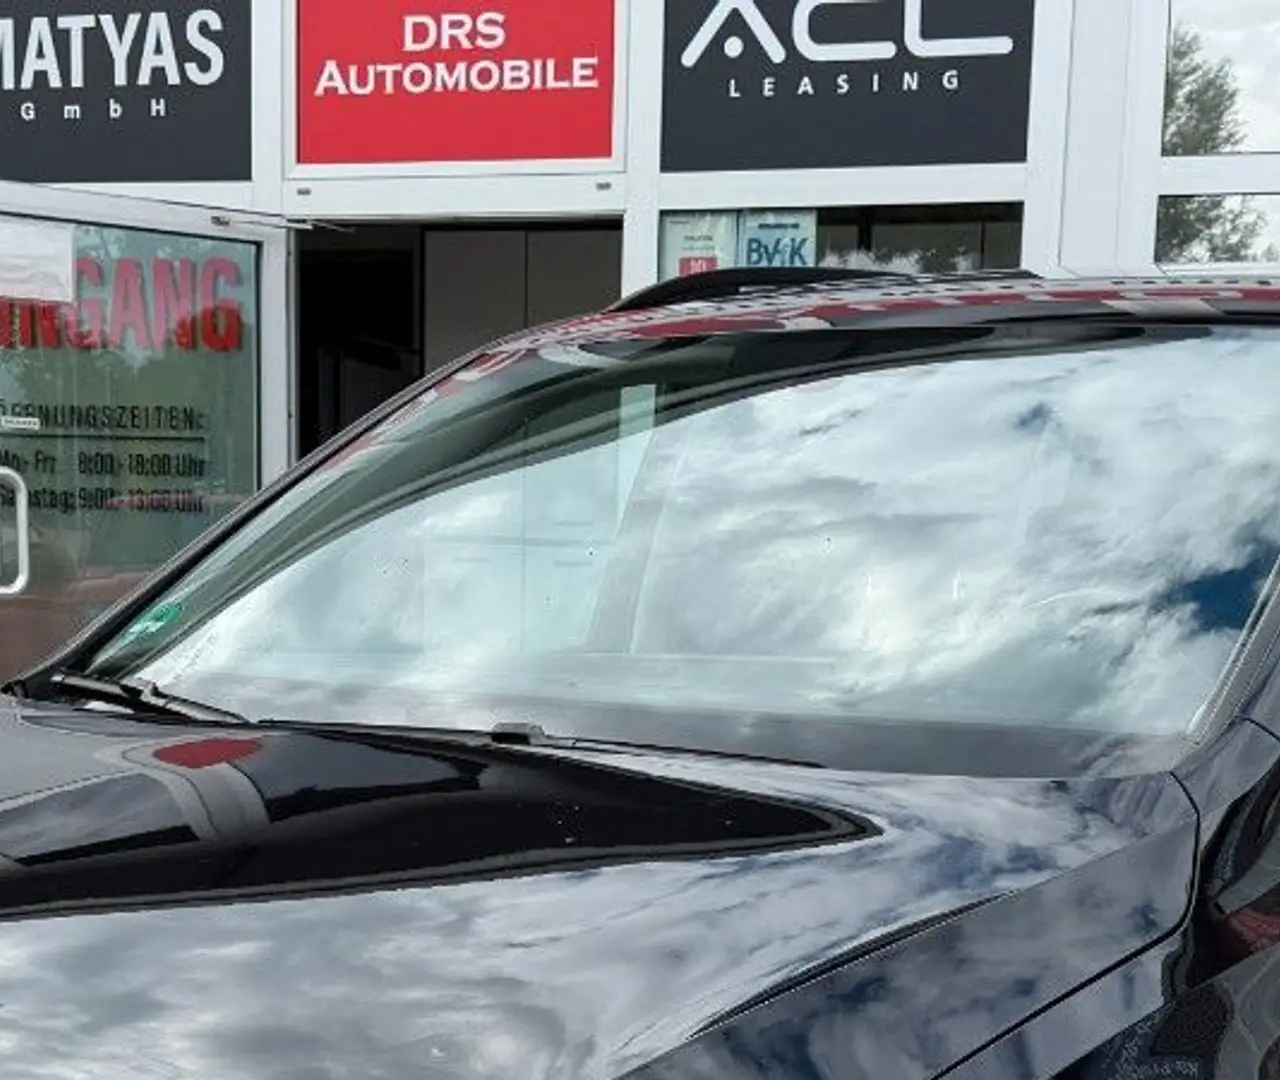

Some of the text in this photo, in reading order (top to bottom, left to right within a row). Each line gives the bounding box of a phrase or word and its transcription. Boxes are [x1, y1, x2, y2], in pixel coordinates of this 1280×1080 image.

[403, 12, 506, 52] DRS
[314, 57, 599, 96] AUTOMOBILE
[729, 69, 959, 98] LEASING
[20, 98, 165, 121] GmbH
[176, 453, 205, 477] Uhr
